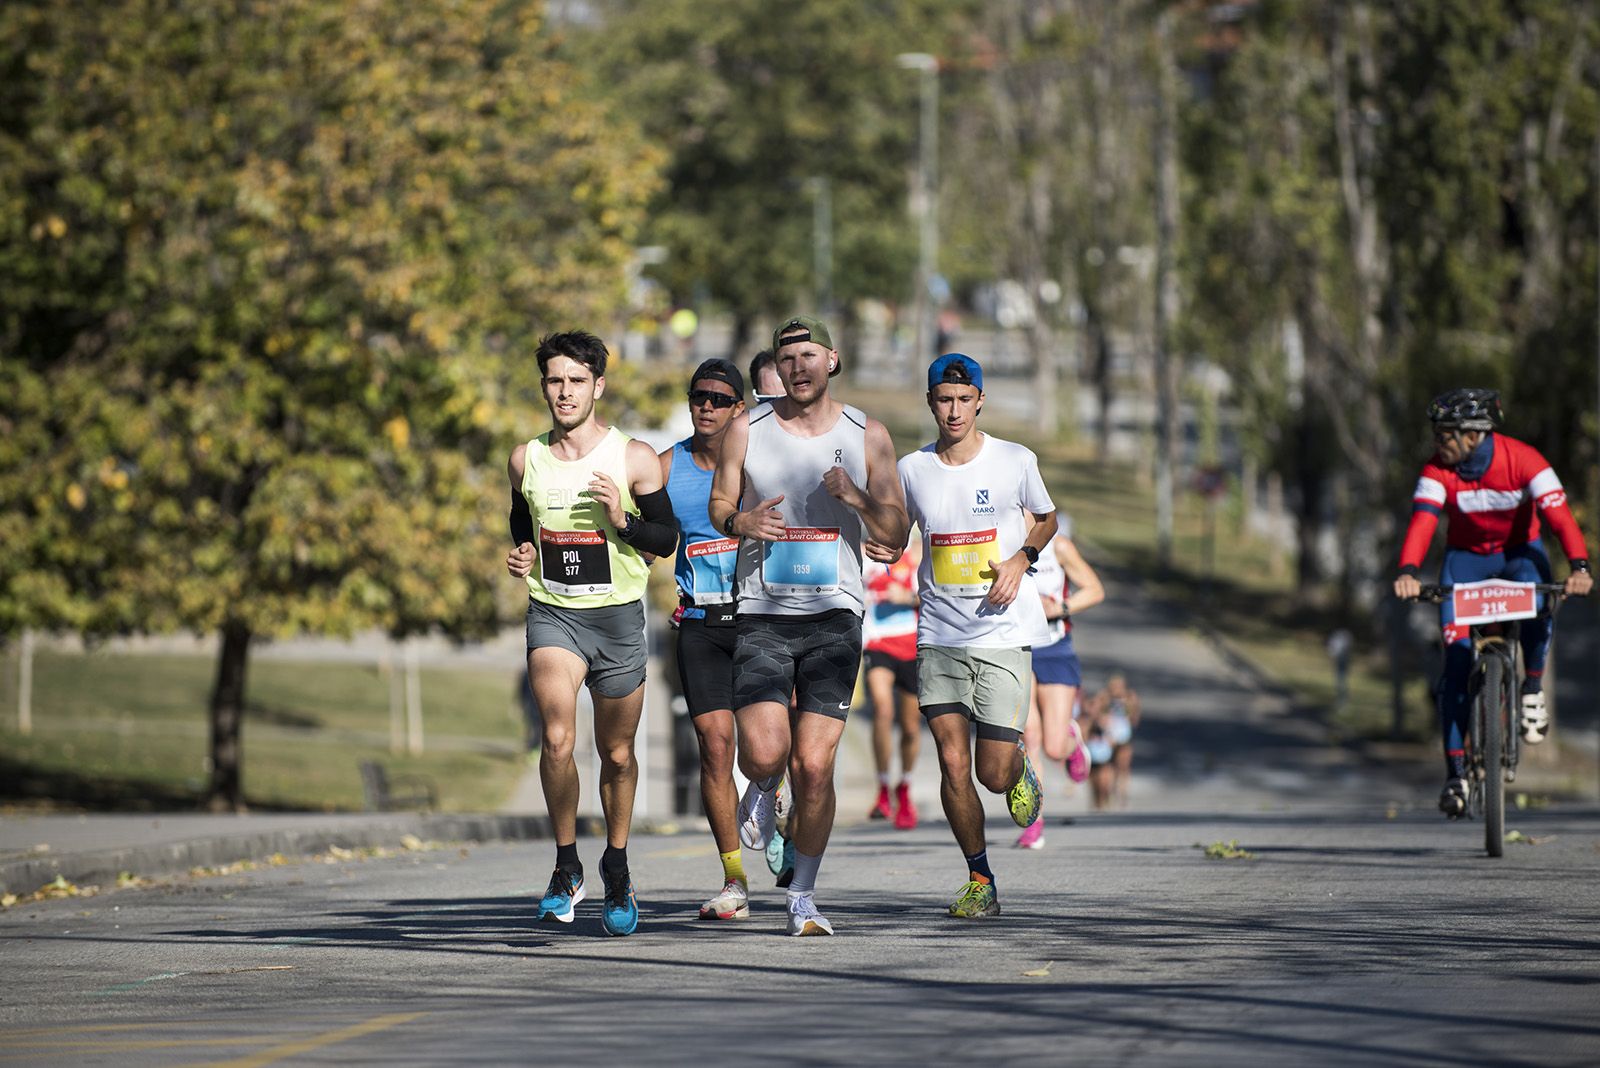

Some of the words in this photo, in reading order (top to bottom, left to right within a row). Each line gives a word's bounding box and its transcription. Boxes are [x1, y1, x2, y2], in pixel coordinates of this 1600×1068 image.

[972, 505, 995, 513] VIARÓ
[562, 550, 582, 564] POL
[951, 552, 979, 565] DAVID
[565, 565, 580, 576] 577
[793, 564, 811, 575] 1359
[1481, 600, 1508, 615] 21K
